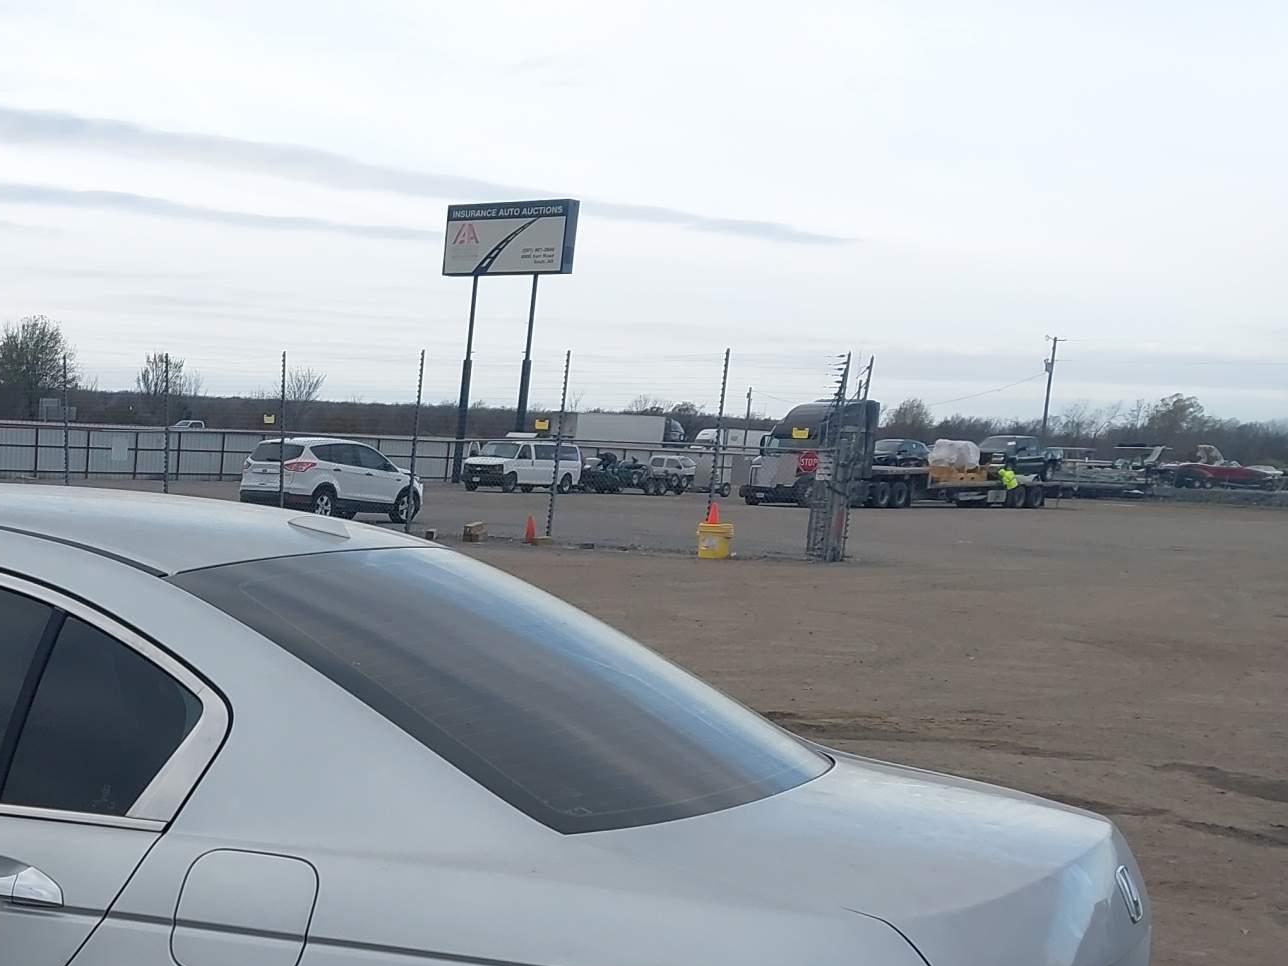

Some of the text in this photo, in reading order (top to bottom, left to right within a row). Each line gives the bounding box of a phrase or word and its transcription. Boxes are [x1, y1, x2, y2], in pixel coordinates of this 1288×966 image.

[452, 205, 563, 219] INSURANCE AUTO AUCTIONS
[801, 458, 817, 466] STOP
